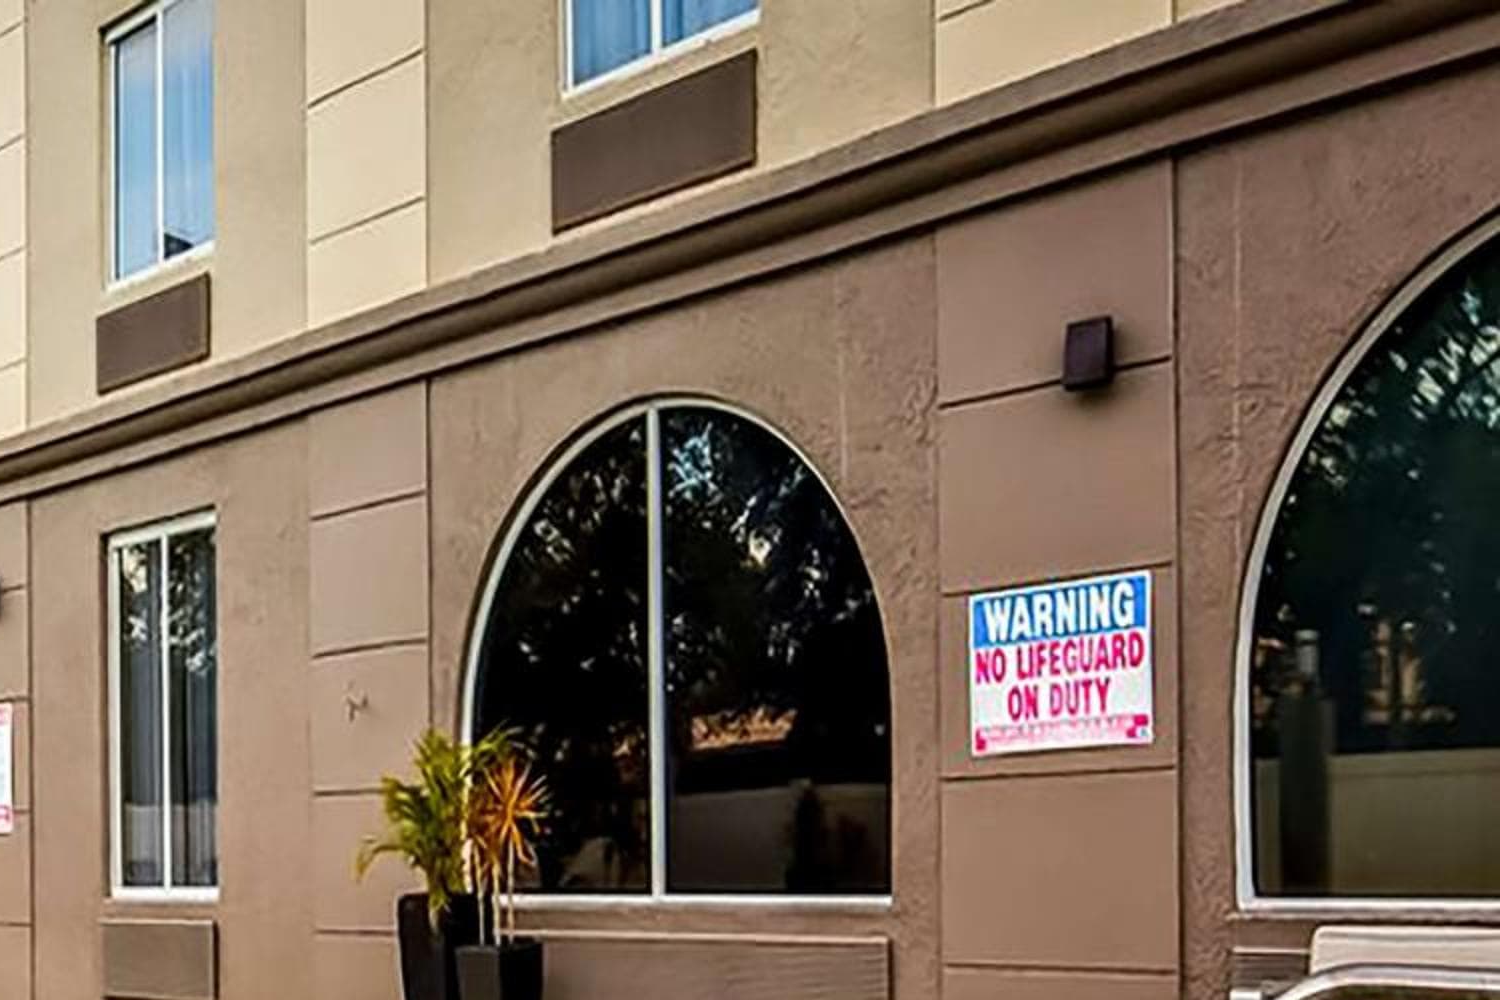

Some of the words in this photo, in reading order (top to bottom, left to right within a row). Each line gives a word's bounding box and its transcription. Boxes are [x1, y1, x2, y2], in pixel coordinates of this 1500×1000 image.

[984, 581, 1135, 643] WARNING
[975, 648, 1007, 684] NO
[1016, 631, 1145, 680] LIFEGUARD
[1007, 684, 1039, 720] ON
[1050, 677, 1111, 716] DUTY
